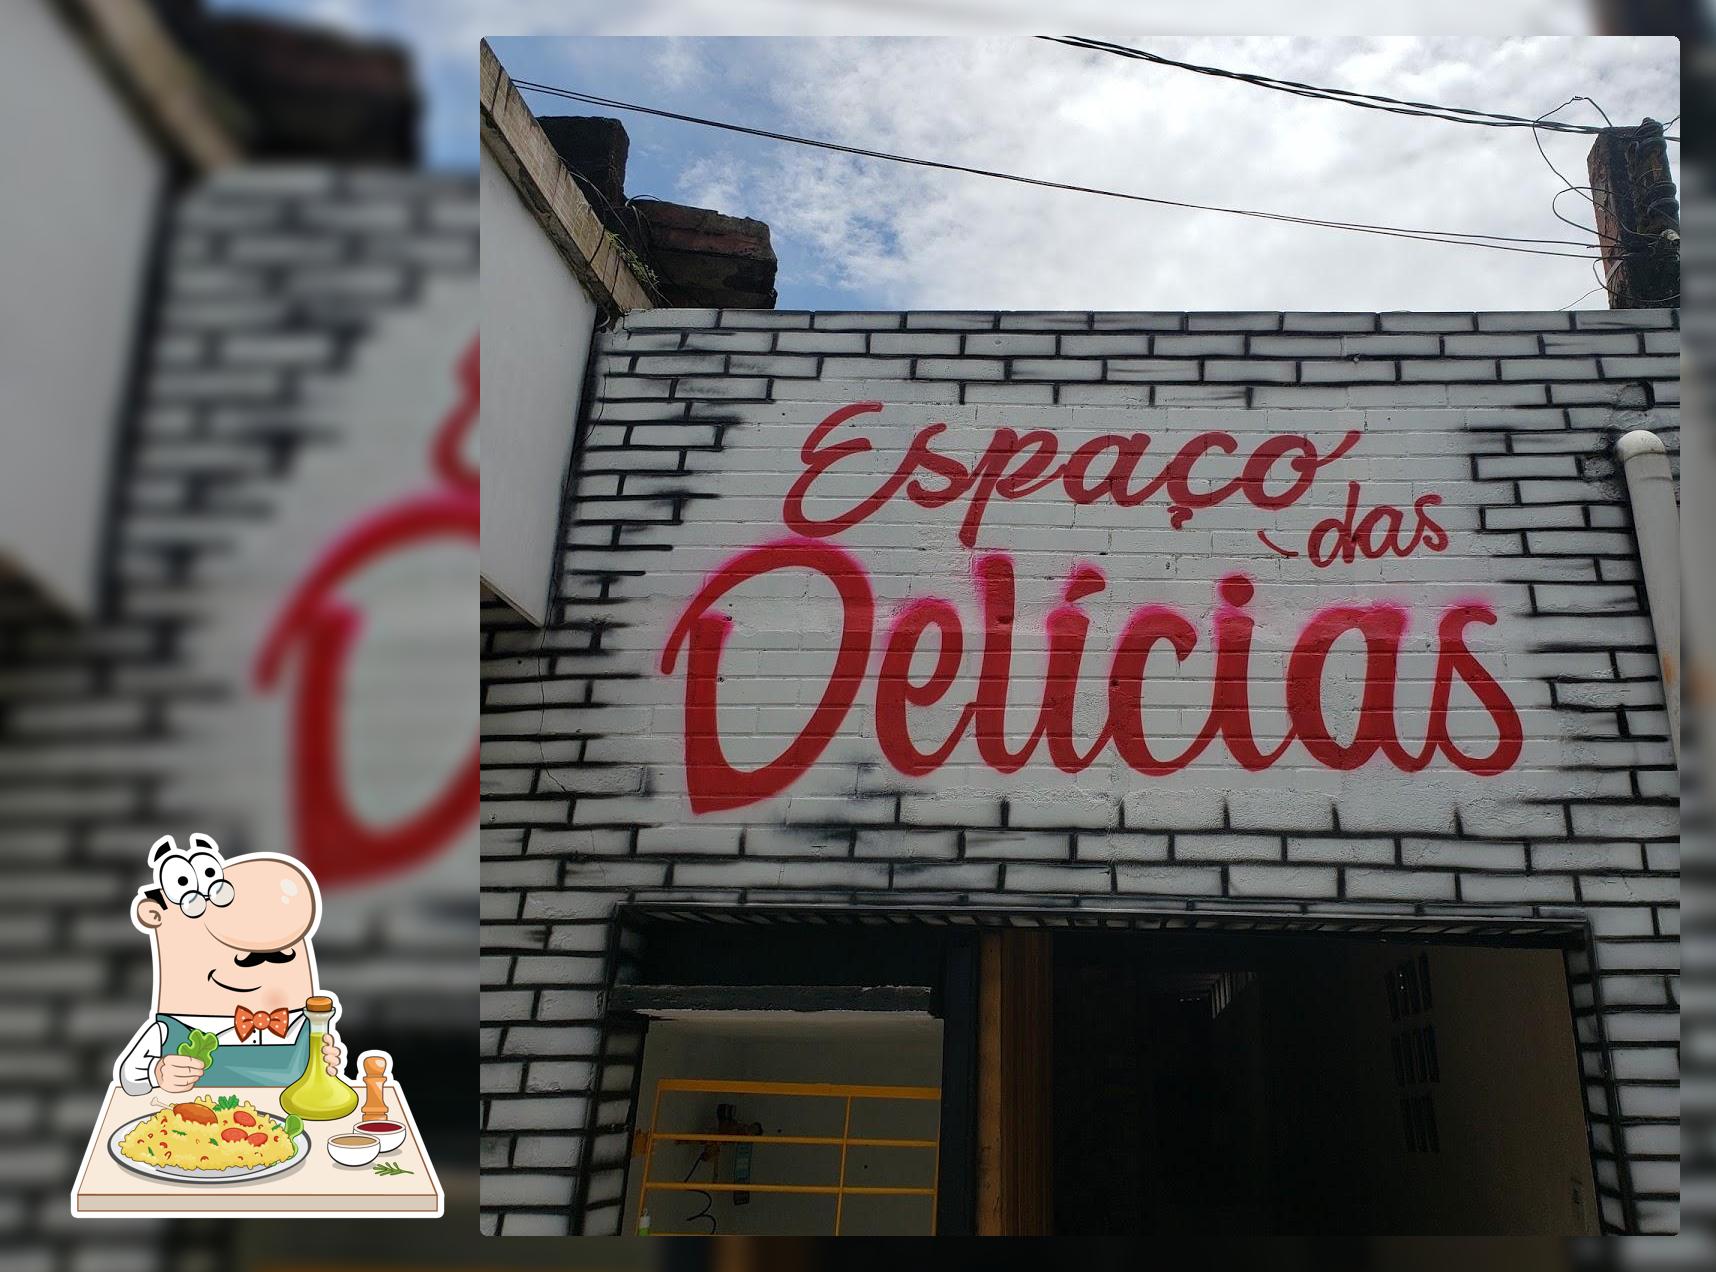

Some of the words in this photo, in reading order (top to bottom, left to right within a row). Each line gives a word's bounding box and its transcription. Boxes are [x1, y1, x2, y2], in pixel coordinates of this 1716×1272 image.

[783, 401, 1361, 548] Espaço
[1308, 482, 1449, 568] das
[661, 538, 1524, 815] Delícias
